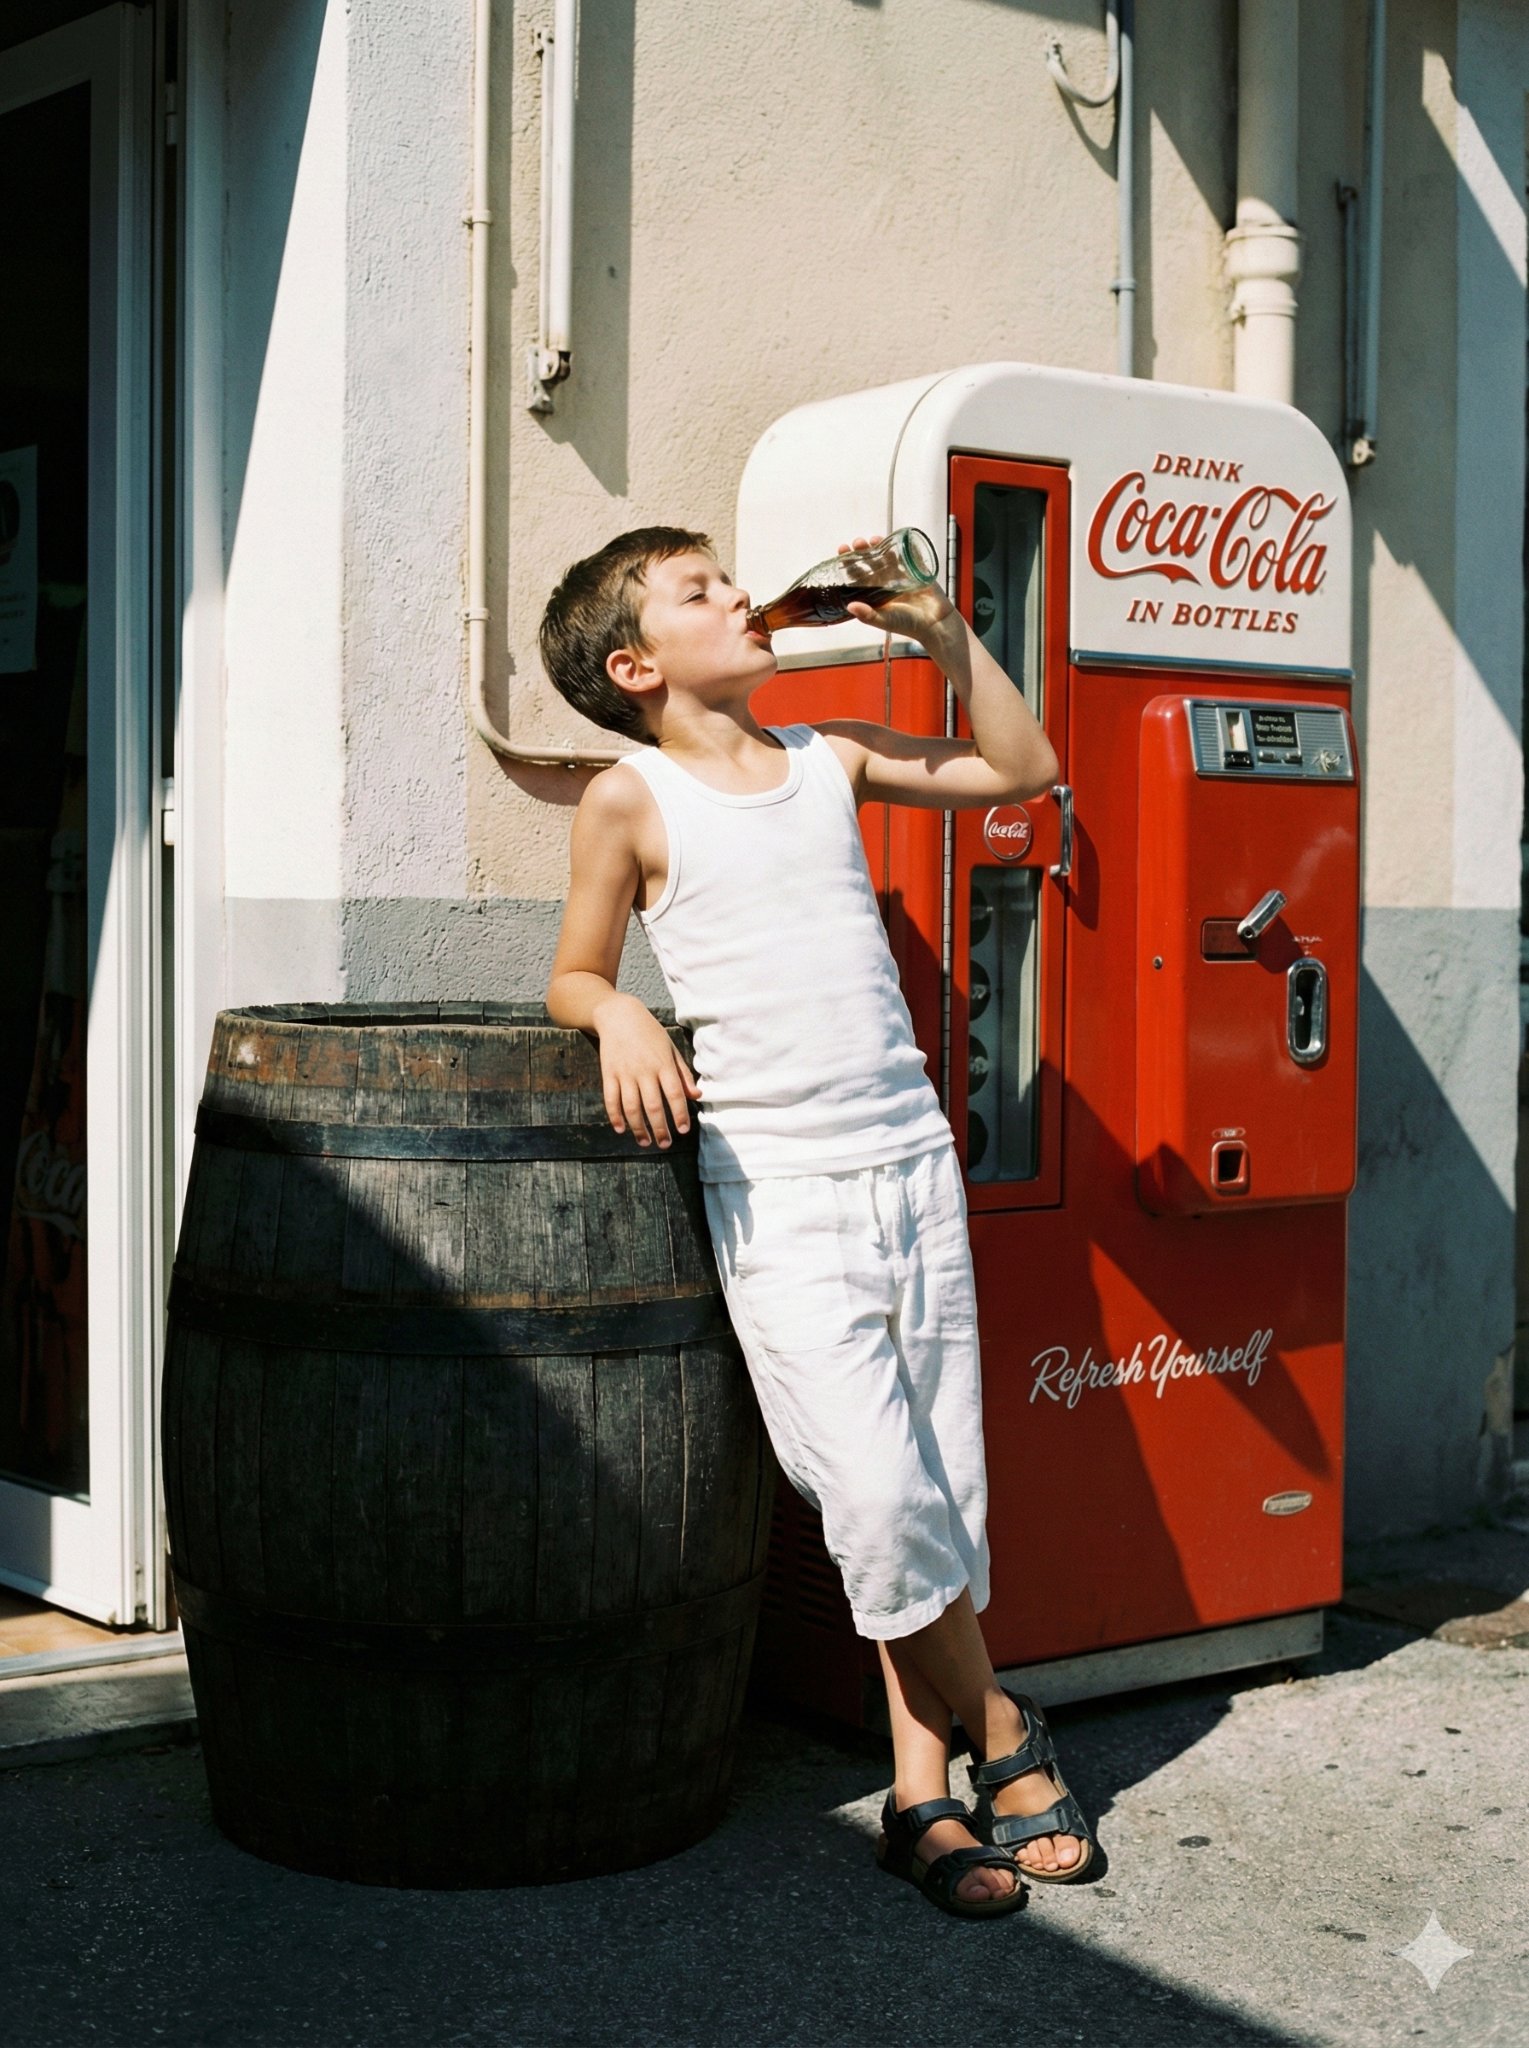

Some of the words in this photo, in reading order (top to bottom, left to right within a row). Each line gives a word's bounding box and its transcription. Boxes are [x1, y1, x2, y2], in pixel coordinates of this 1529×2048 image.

[1152, 453, 1244, 483] DRINK
[1087, 471, 1338, 595] Coca-Cola
[1127, 600, 1163, 623] IN
[1171, 603, 1299, 634] BOTTLES
[1029, 1342, 1145, 1409] Refresh
[1148, 1328, 1273, 1398] Yourself
